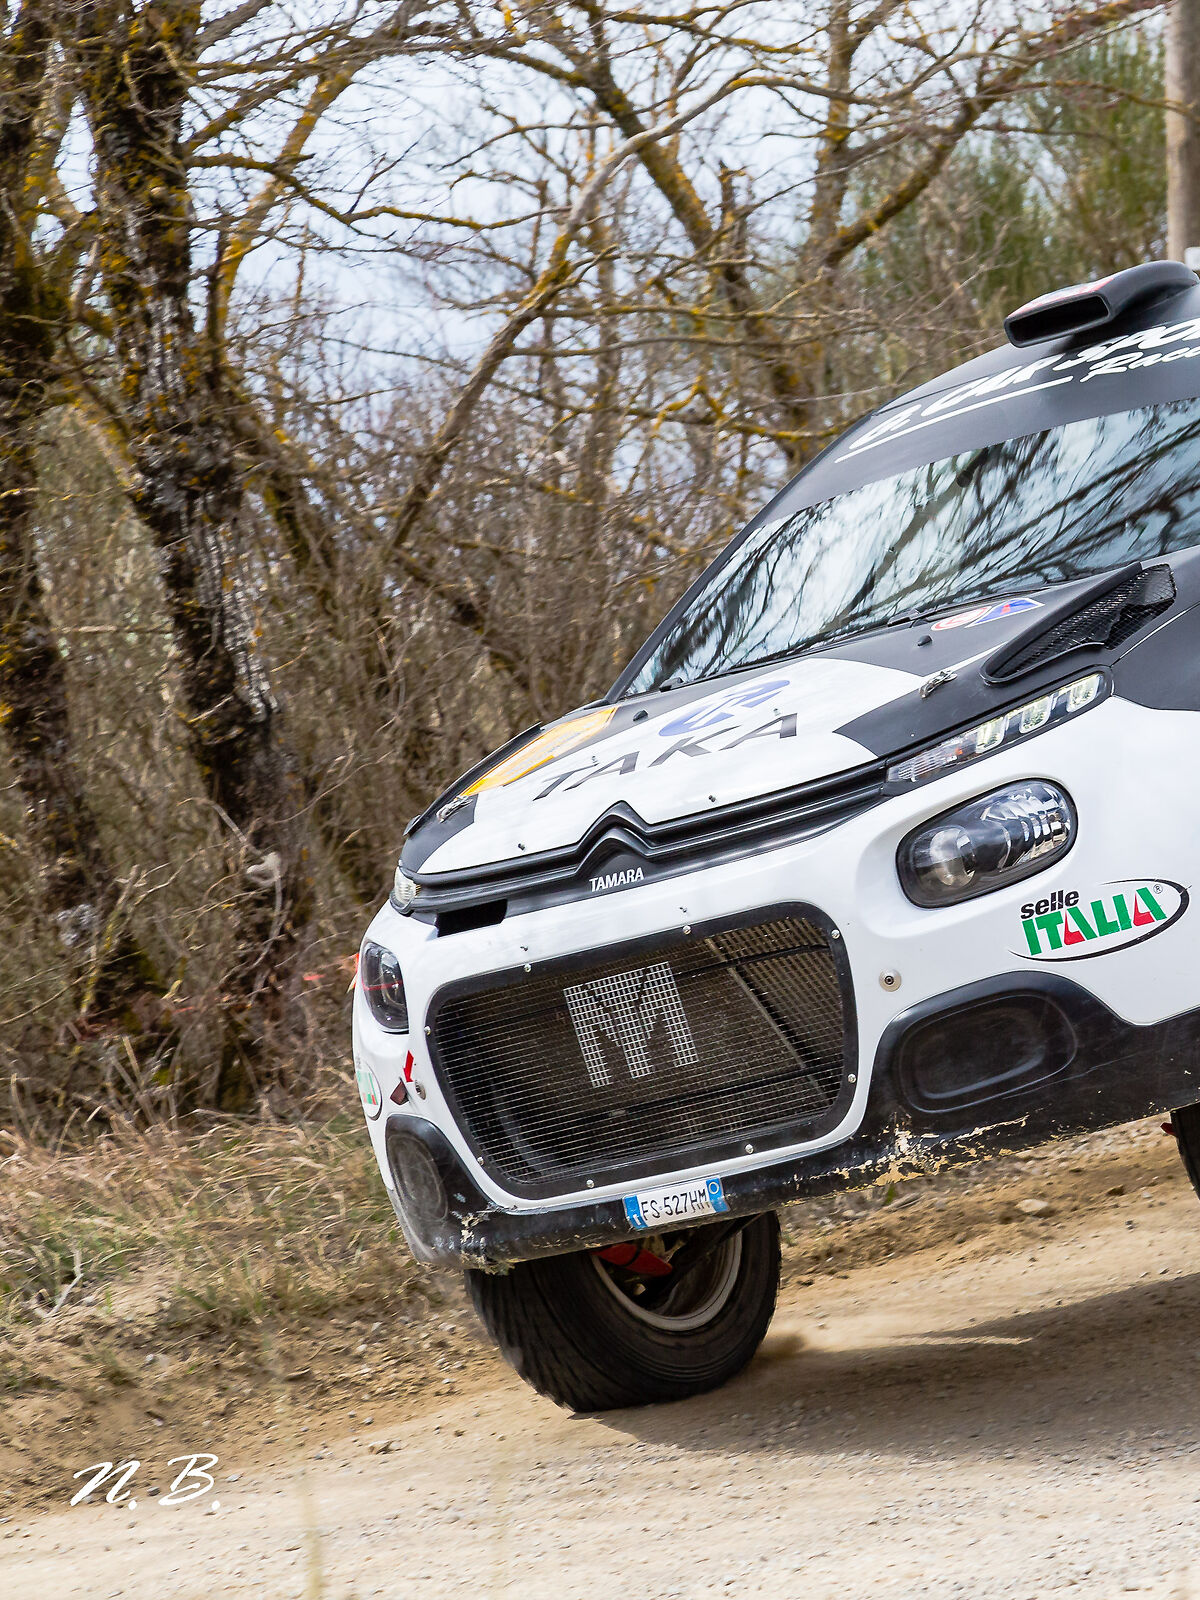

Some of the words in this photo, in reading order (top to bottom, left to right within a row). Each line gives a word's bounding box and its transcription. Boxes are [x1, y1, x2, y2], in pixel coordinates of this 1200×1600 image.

[533, 713, 798, 802] TAKA
[589, 867, 645, 892] TAMARA
[1020, 890, 1079, 919] selle
[1022, 887, 1167, 956] ITALIA
